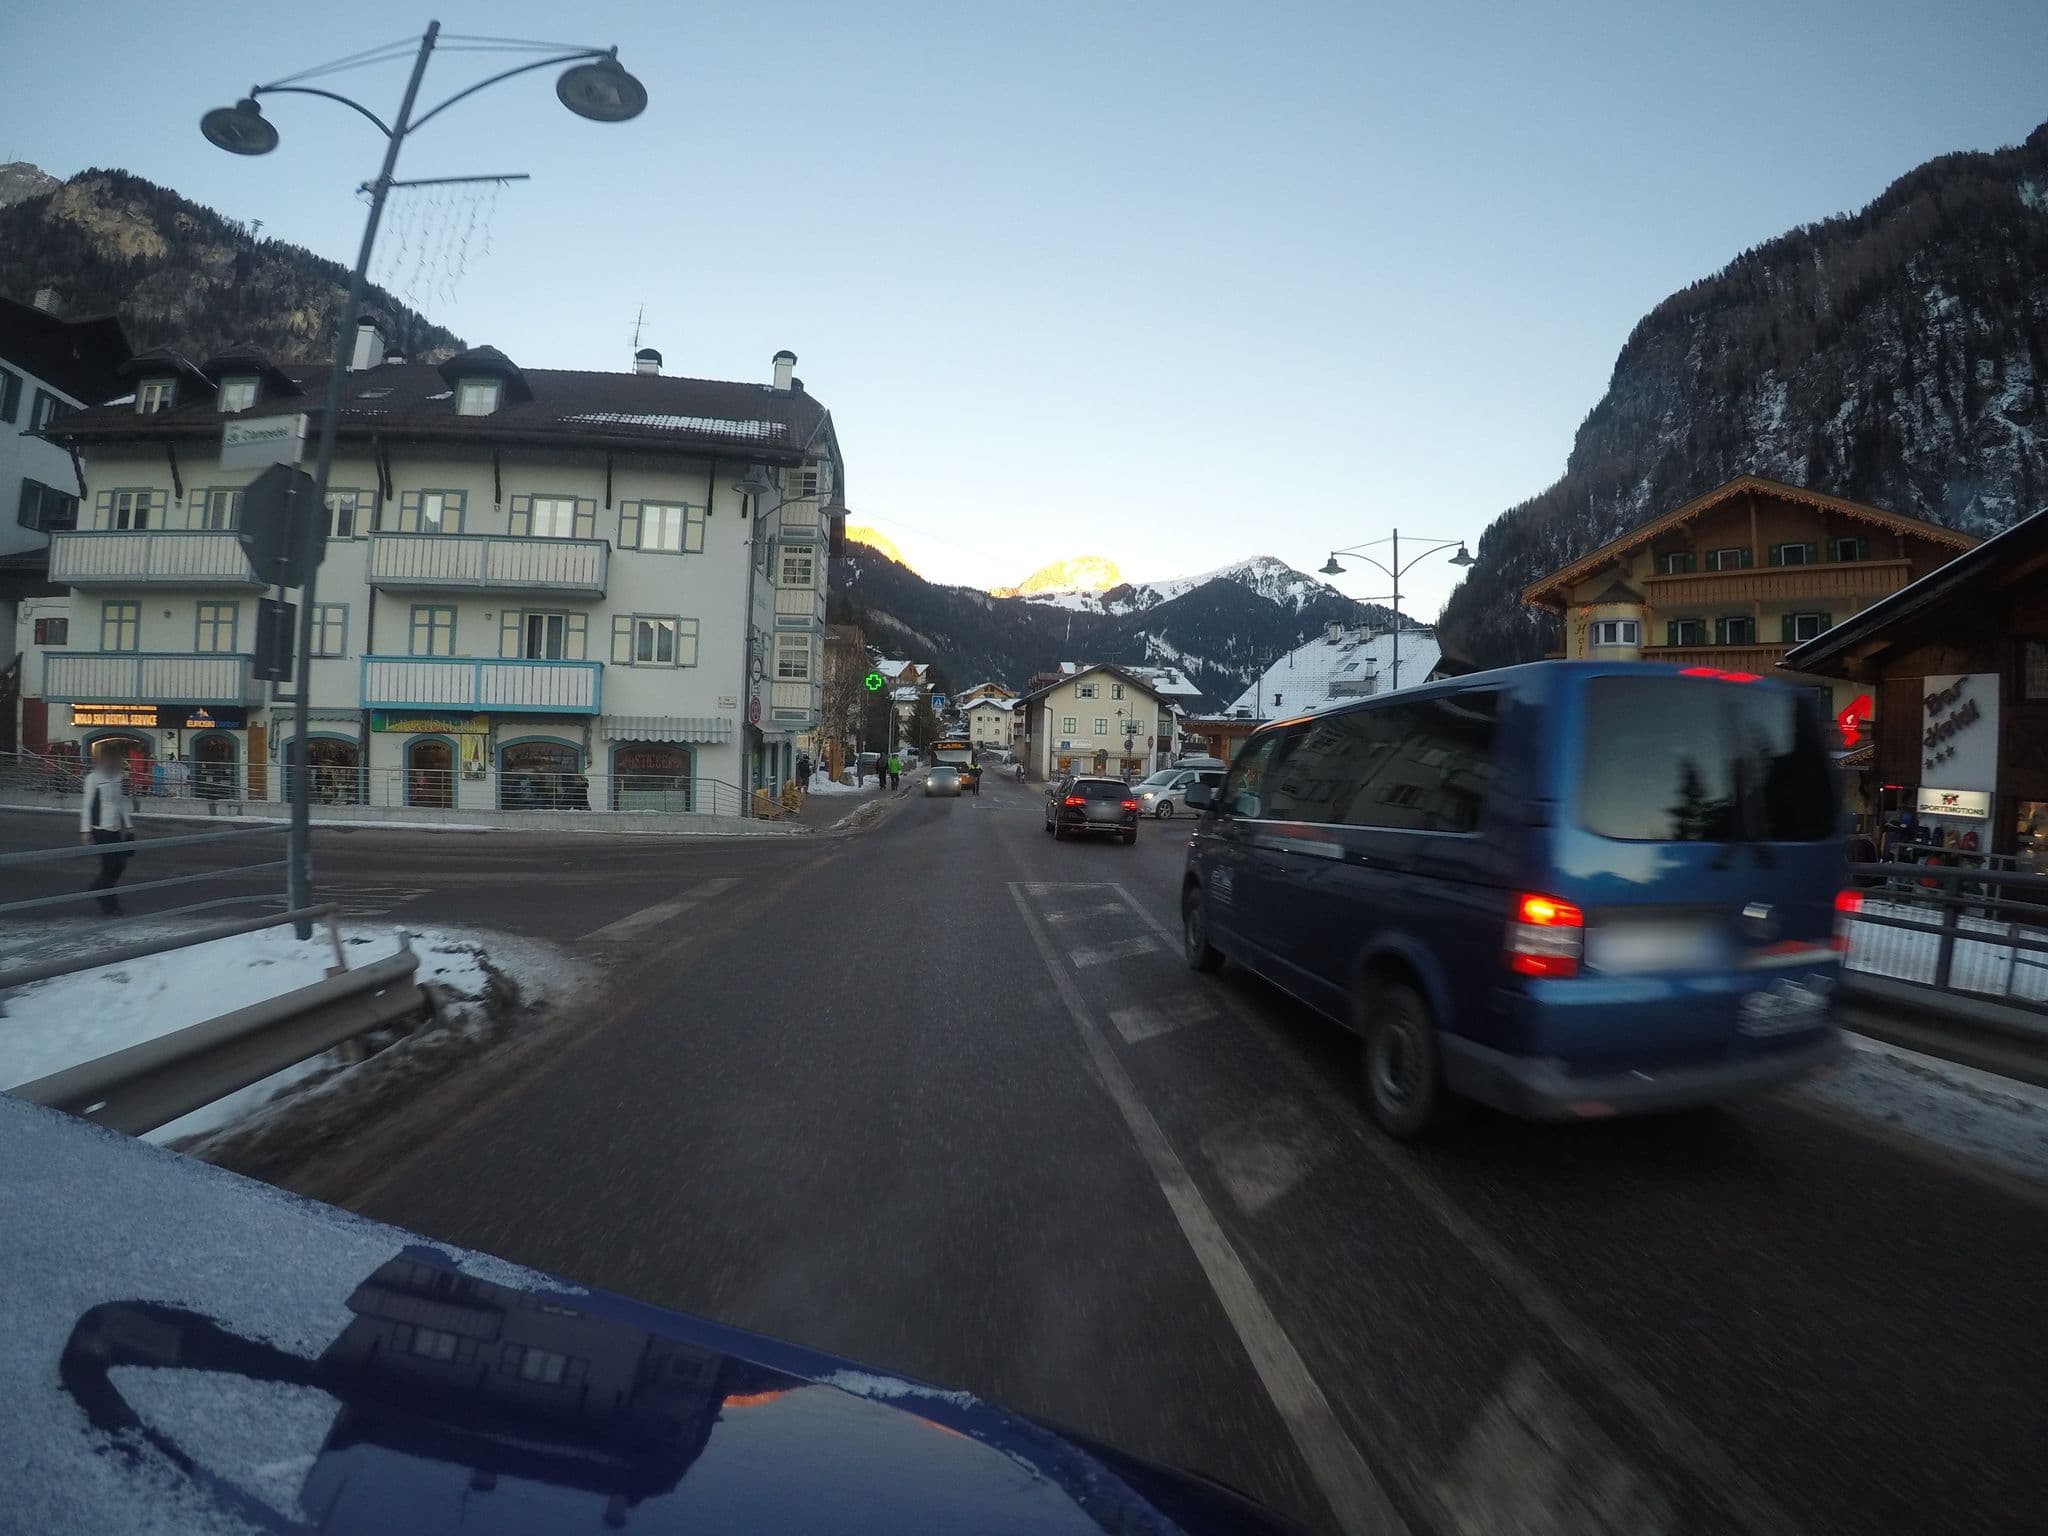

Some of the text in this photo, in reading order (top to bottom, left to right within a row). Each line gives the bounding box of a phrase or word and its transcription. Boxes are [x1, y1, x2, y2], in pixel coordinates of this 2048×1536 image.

[105, 714, 129, 726] RENTAL
[130, 715, 157, 726] SERVICE
[1919, 804, 1985, 816] SPORTEMOTIONS
